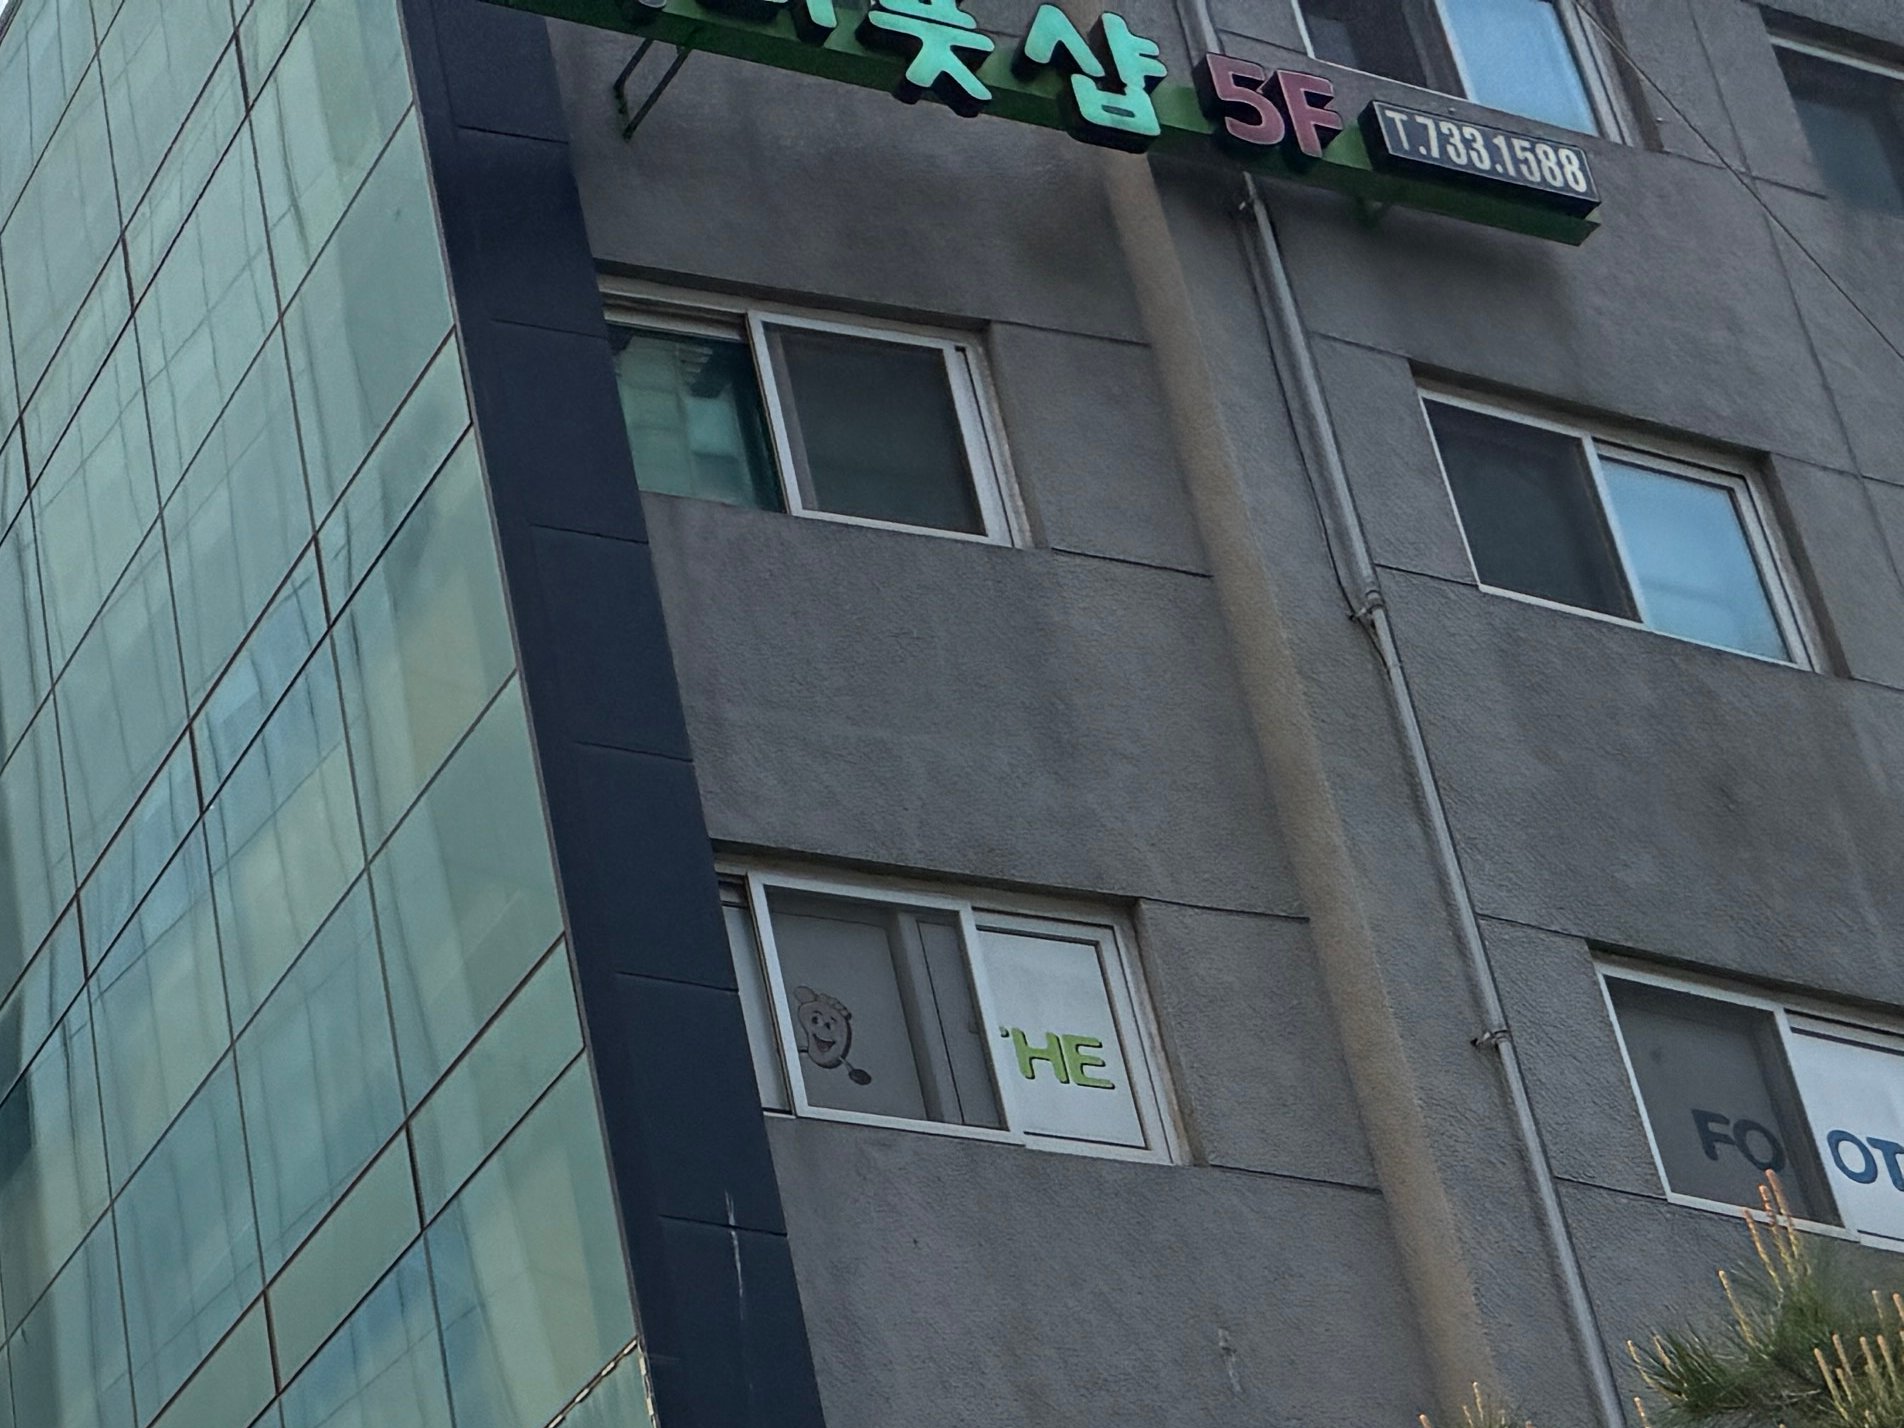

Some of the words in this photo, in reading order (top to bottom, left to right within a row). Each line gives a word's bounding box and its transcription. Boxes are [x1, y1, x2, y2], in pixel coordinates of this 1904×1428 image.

[792, 0, 1168, 136] 풋샵
[1205, 51, 1344, 156] 5F
[1384, 105, 1588, 193] T.733.1588
[1002, 1026, 1115, 1090] HE
